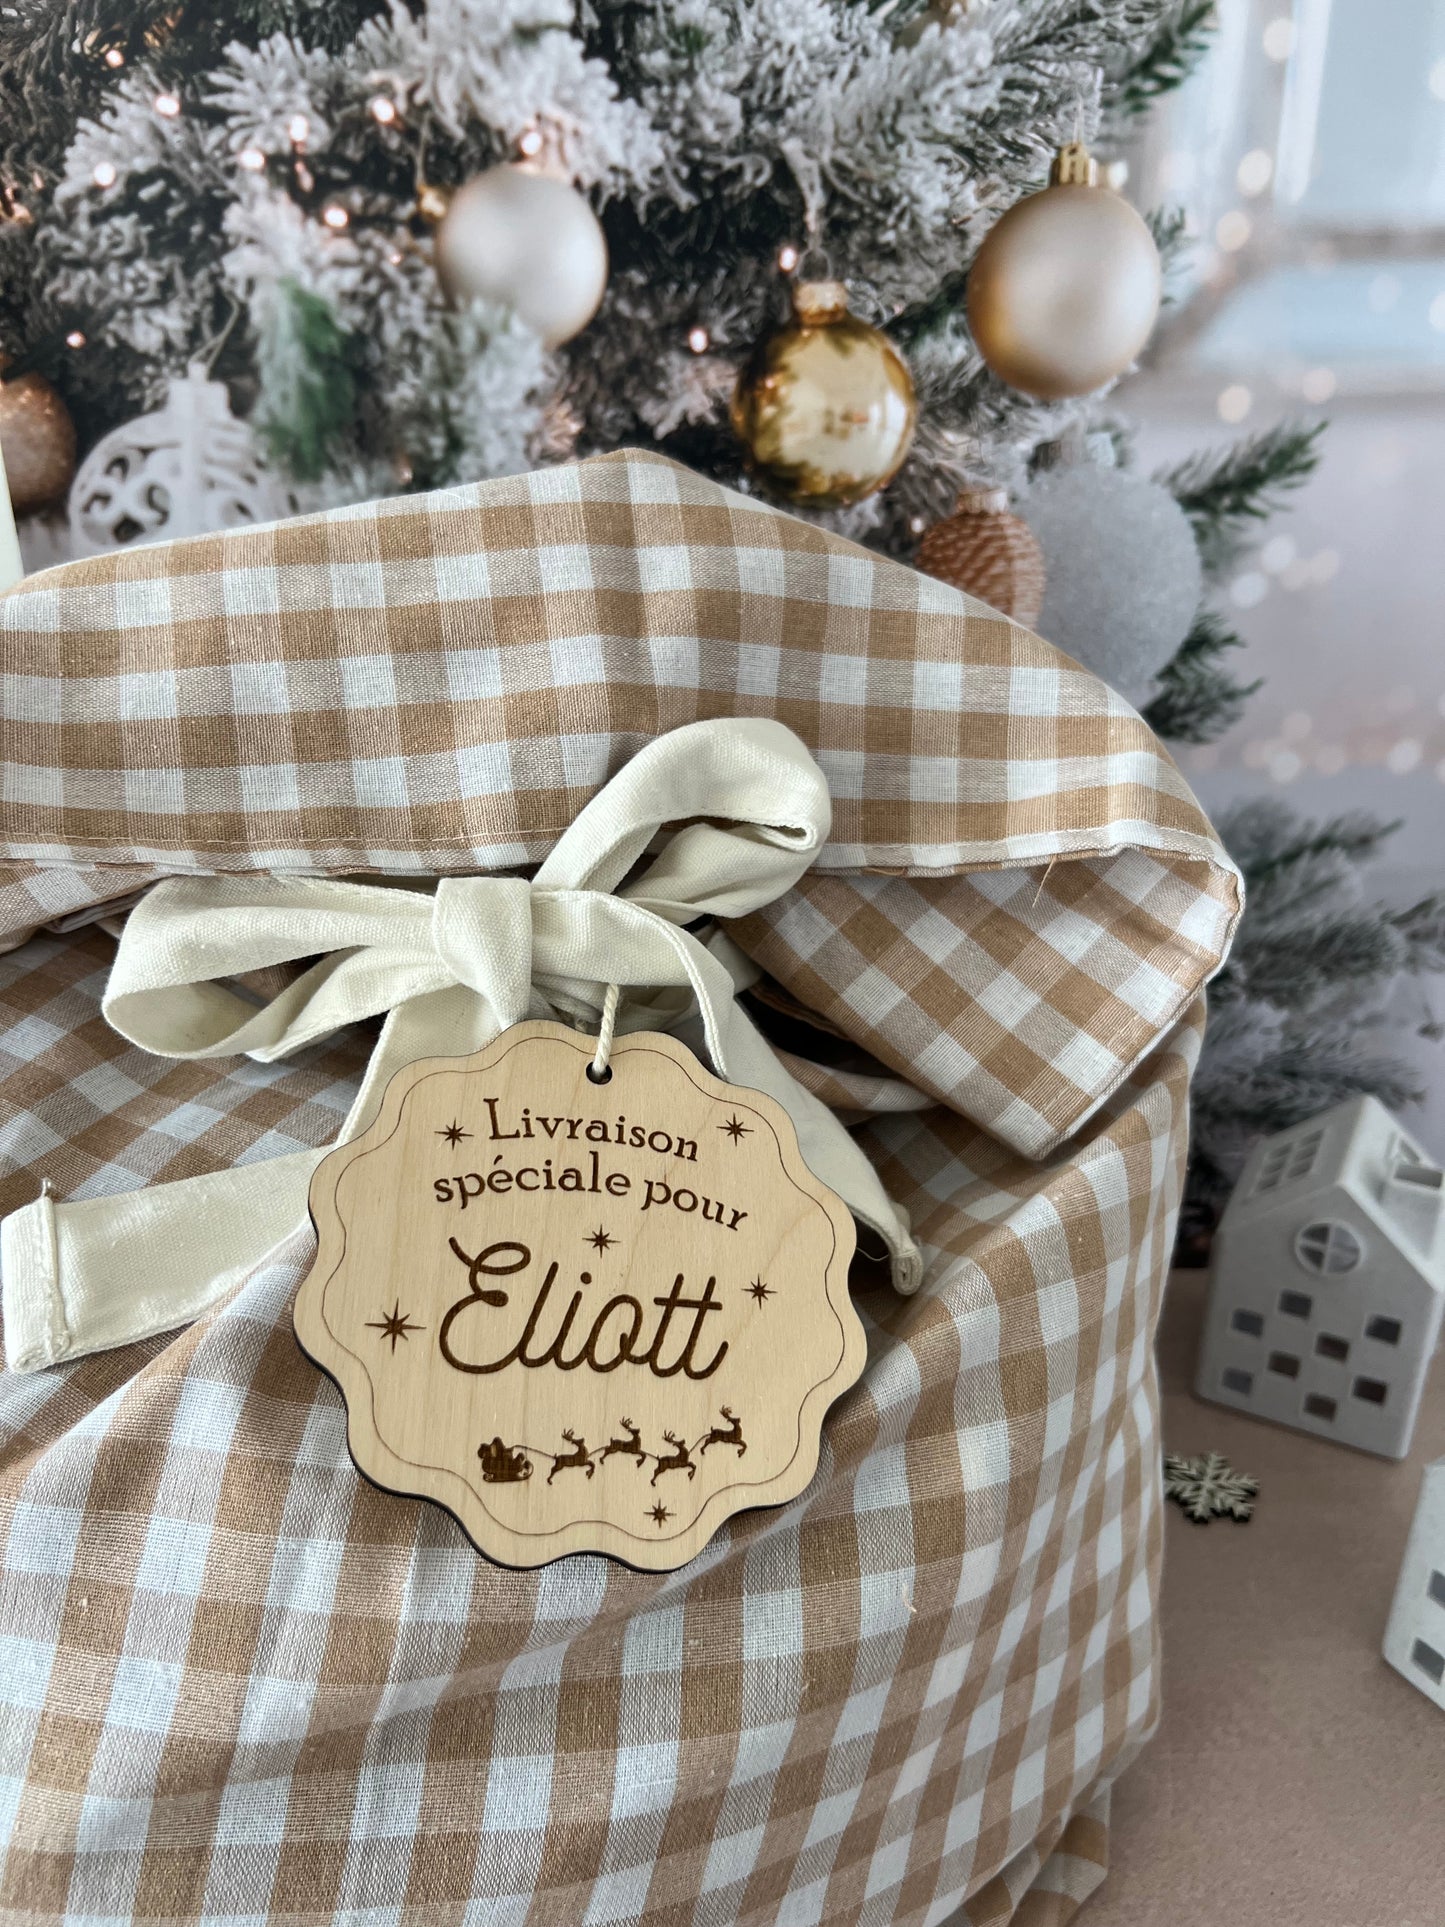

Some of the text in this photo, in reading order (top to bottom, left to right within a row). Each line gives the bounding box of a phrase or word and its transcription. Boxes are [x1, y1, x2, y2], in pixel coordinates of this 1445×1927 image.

[482, 1097, 698, 1163] Livraison
[433, 1150, 749, 1232] spéciale pour
[438, 1236, 730, 1381] Eliott
